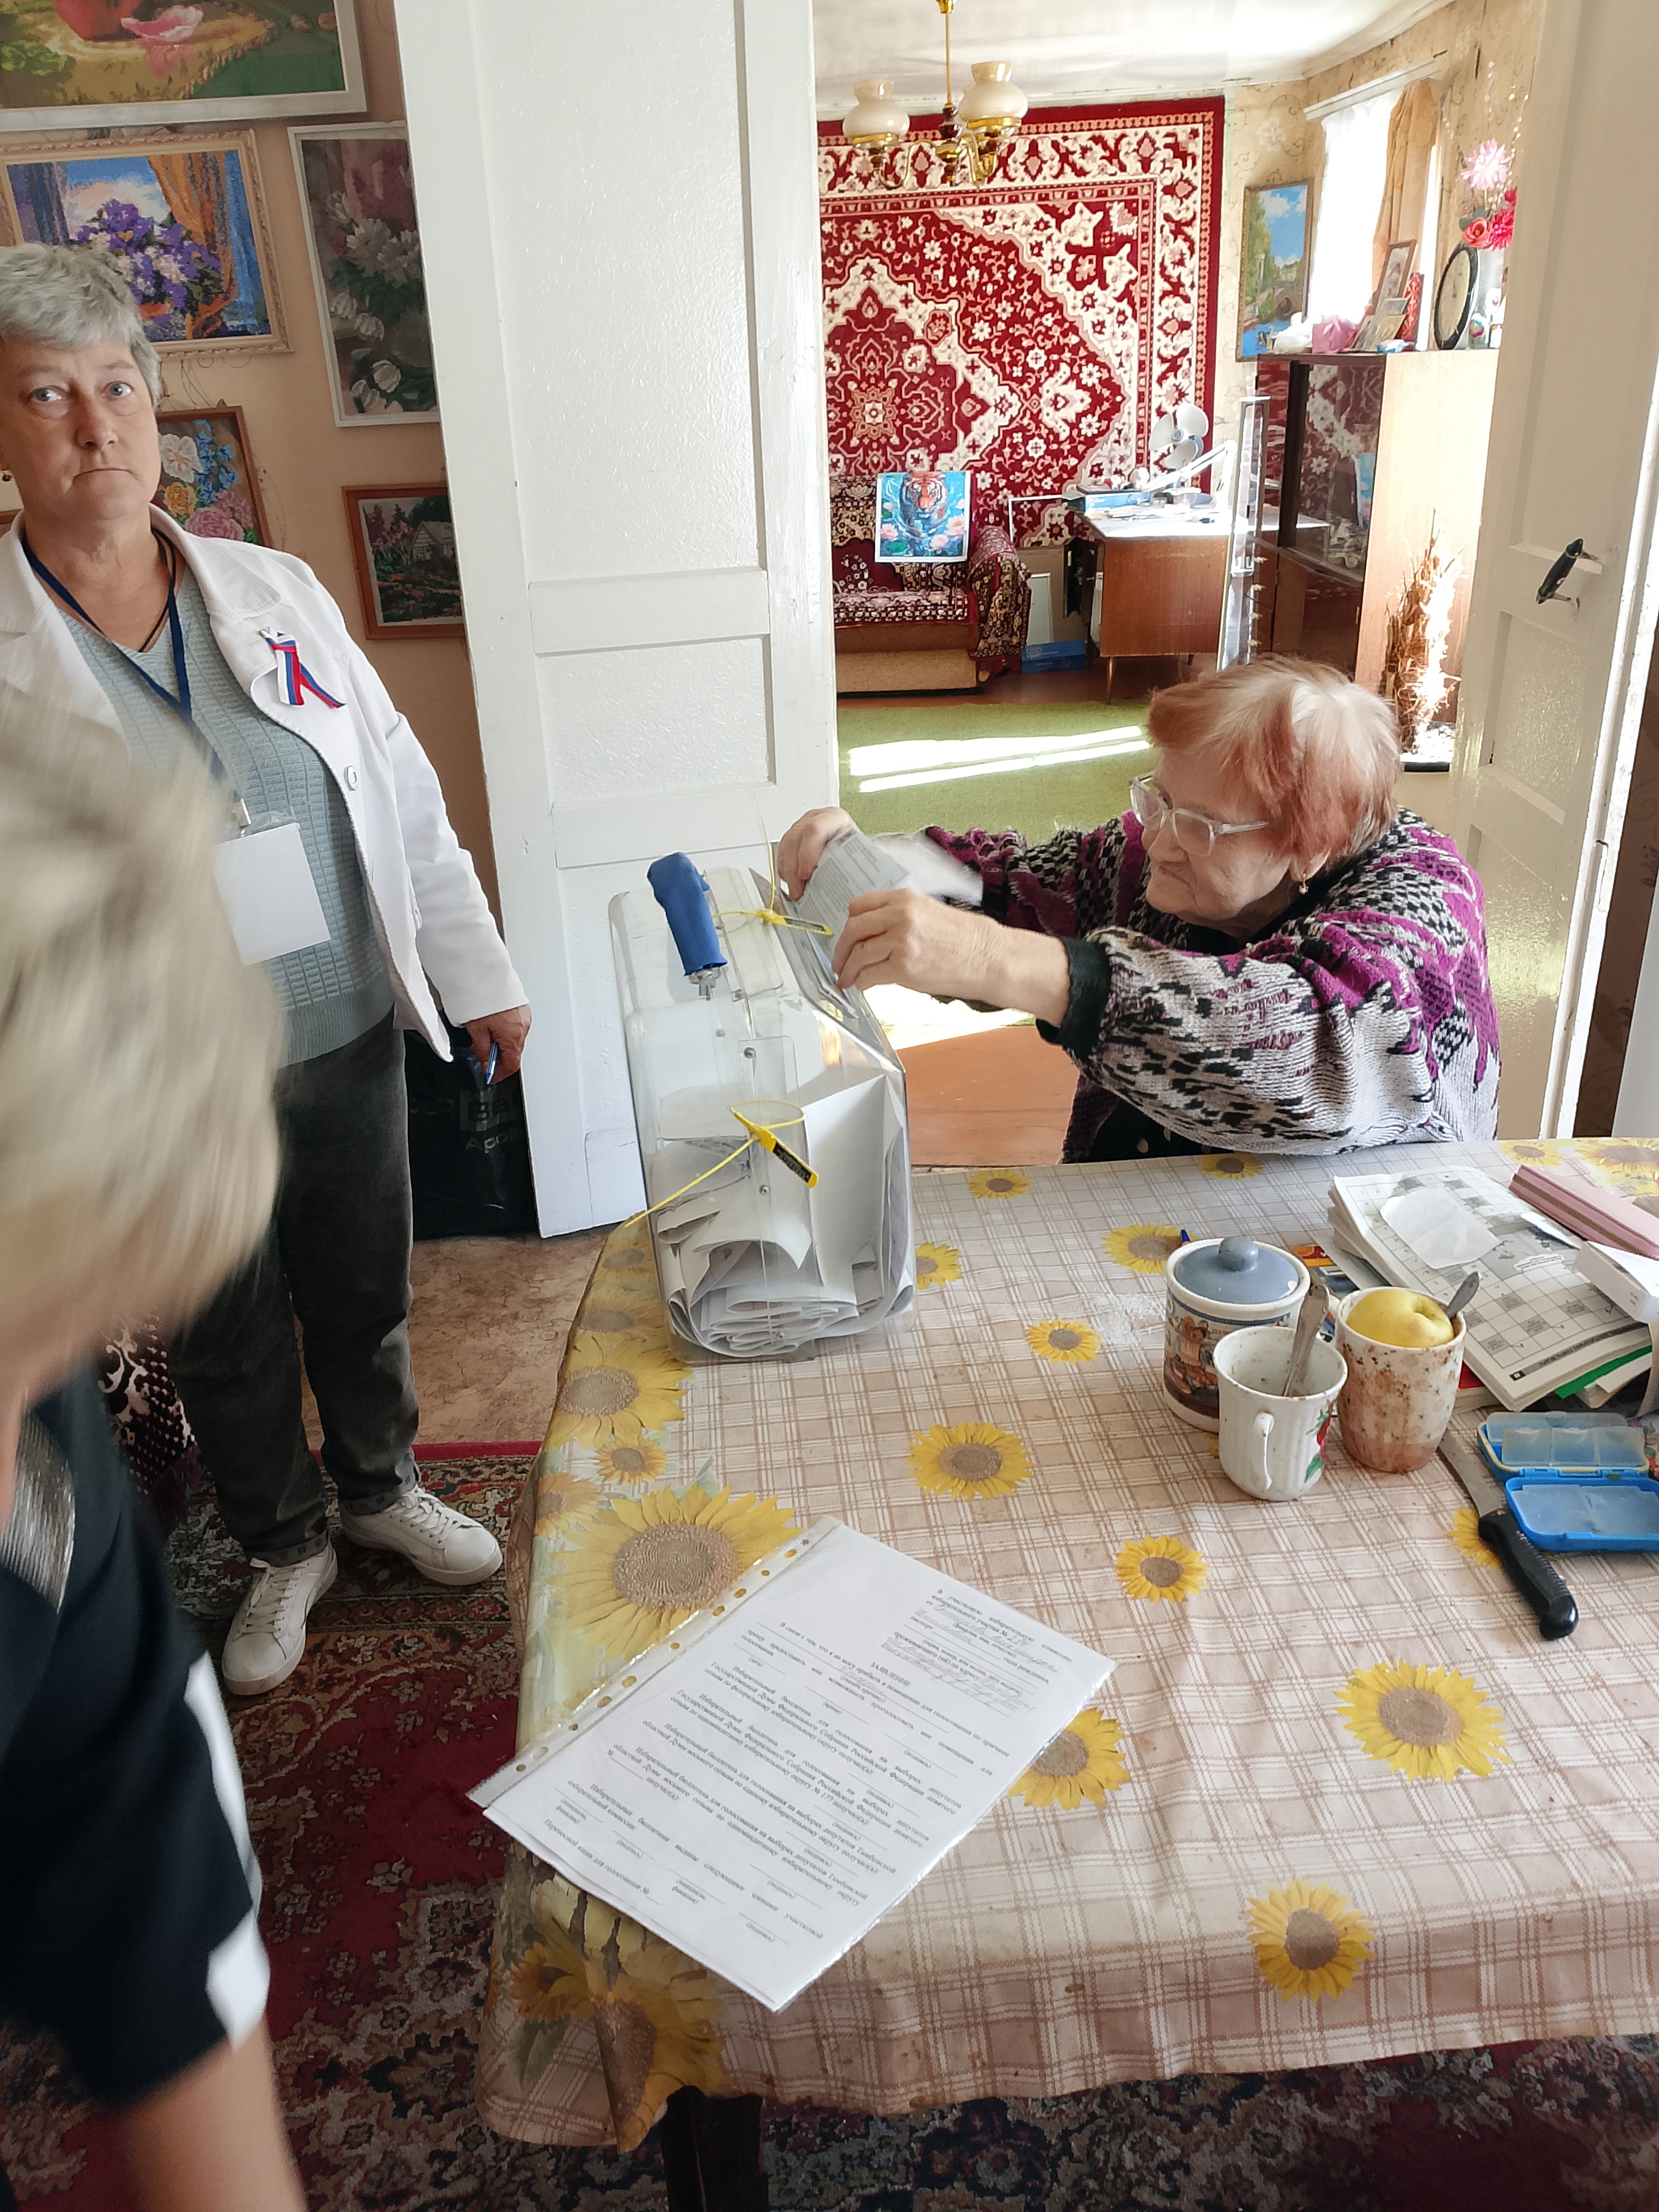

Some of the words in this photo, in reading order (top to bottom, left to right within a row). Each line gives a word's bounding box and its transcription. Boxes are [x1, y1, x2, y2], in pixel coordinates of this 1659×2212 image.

[869, 1661, 911, 1687] ЗАЯВЛЕНИЕ
[856, 1846, 897, 1874] Тамбовской
[827, 1872, 868, 1900] Тамбовской
